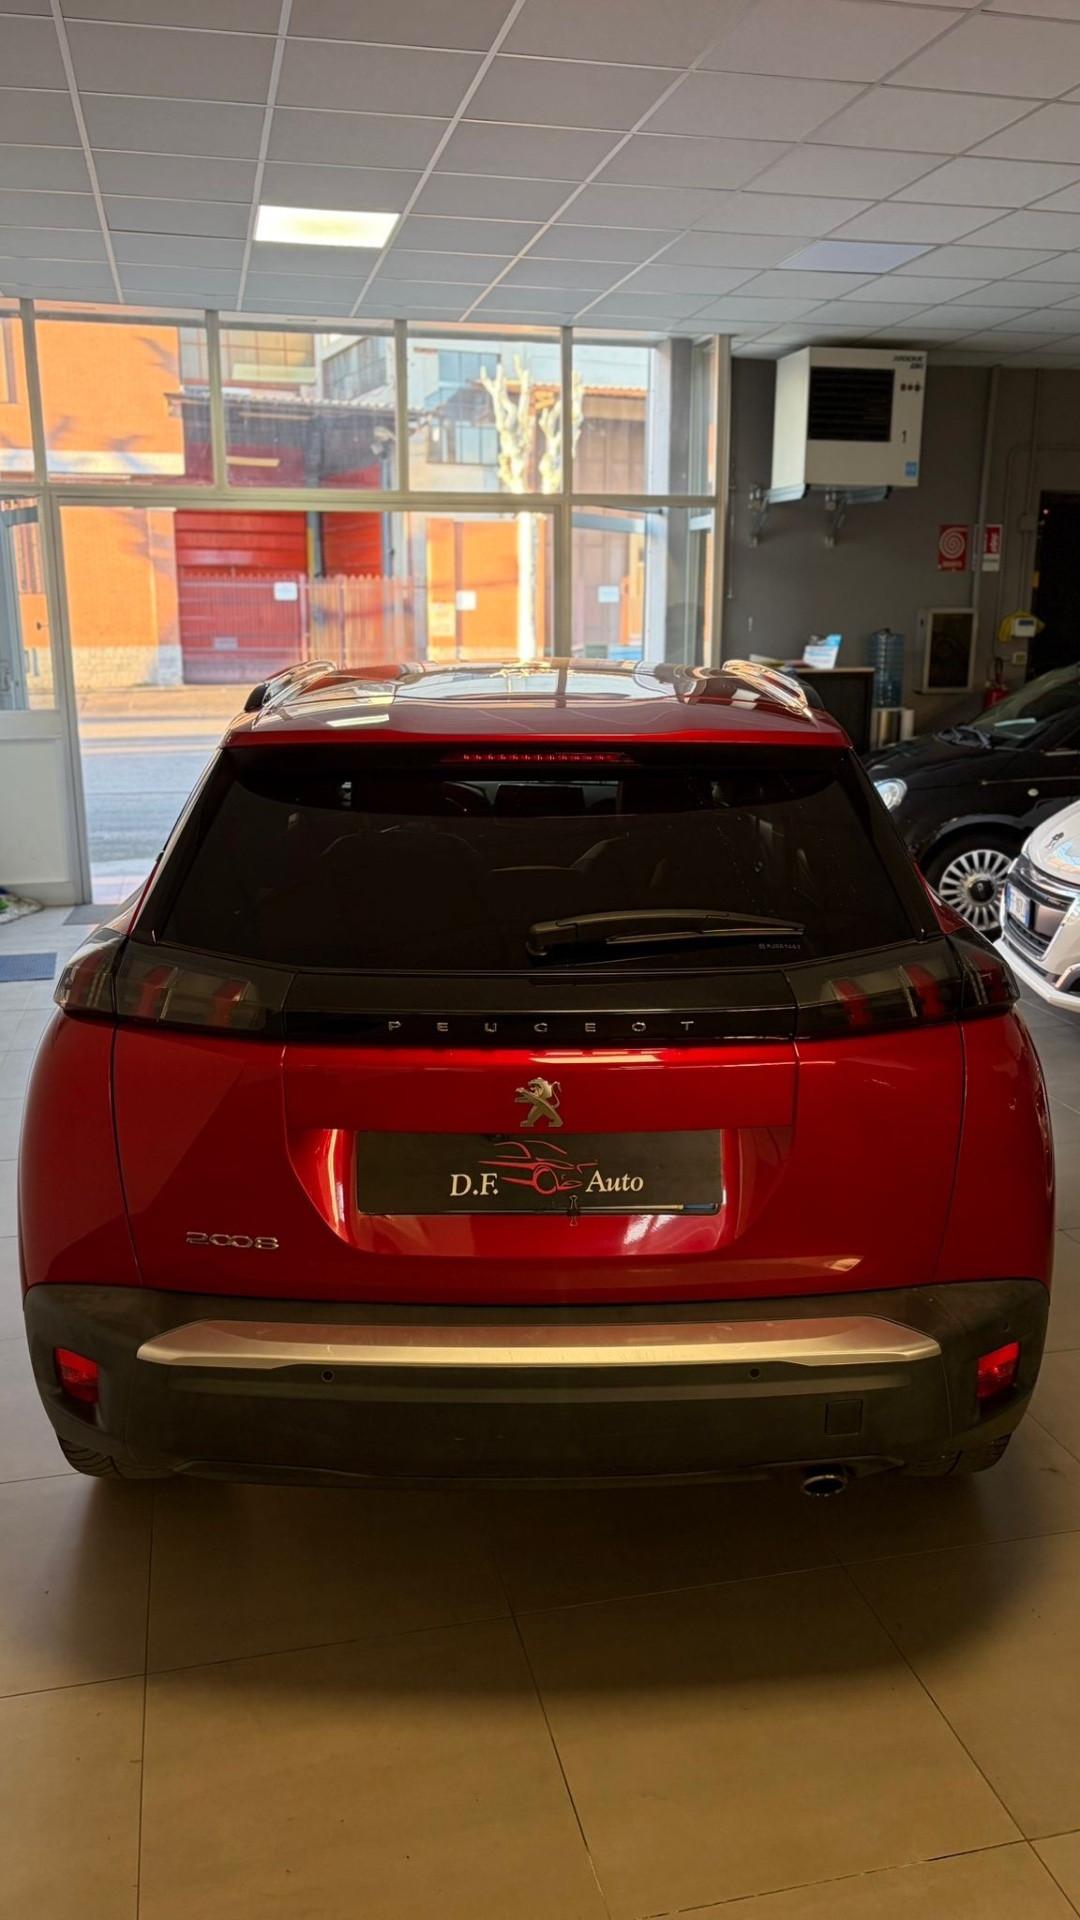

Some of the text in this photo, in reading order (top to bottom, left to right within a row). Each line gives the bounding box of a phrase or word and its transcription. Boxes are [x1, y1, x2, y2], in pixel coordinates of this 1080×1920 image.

[388, 1020, 695, 1033] PEUGEOT
[450, 1169, 645, 1197] D.F. Auto
[186, 1231, 280, 1250] 2008
